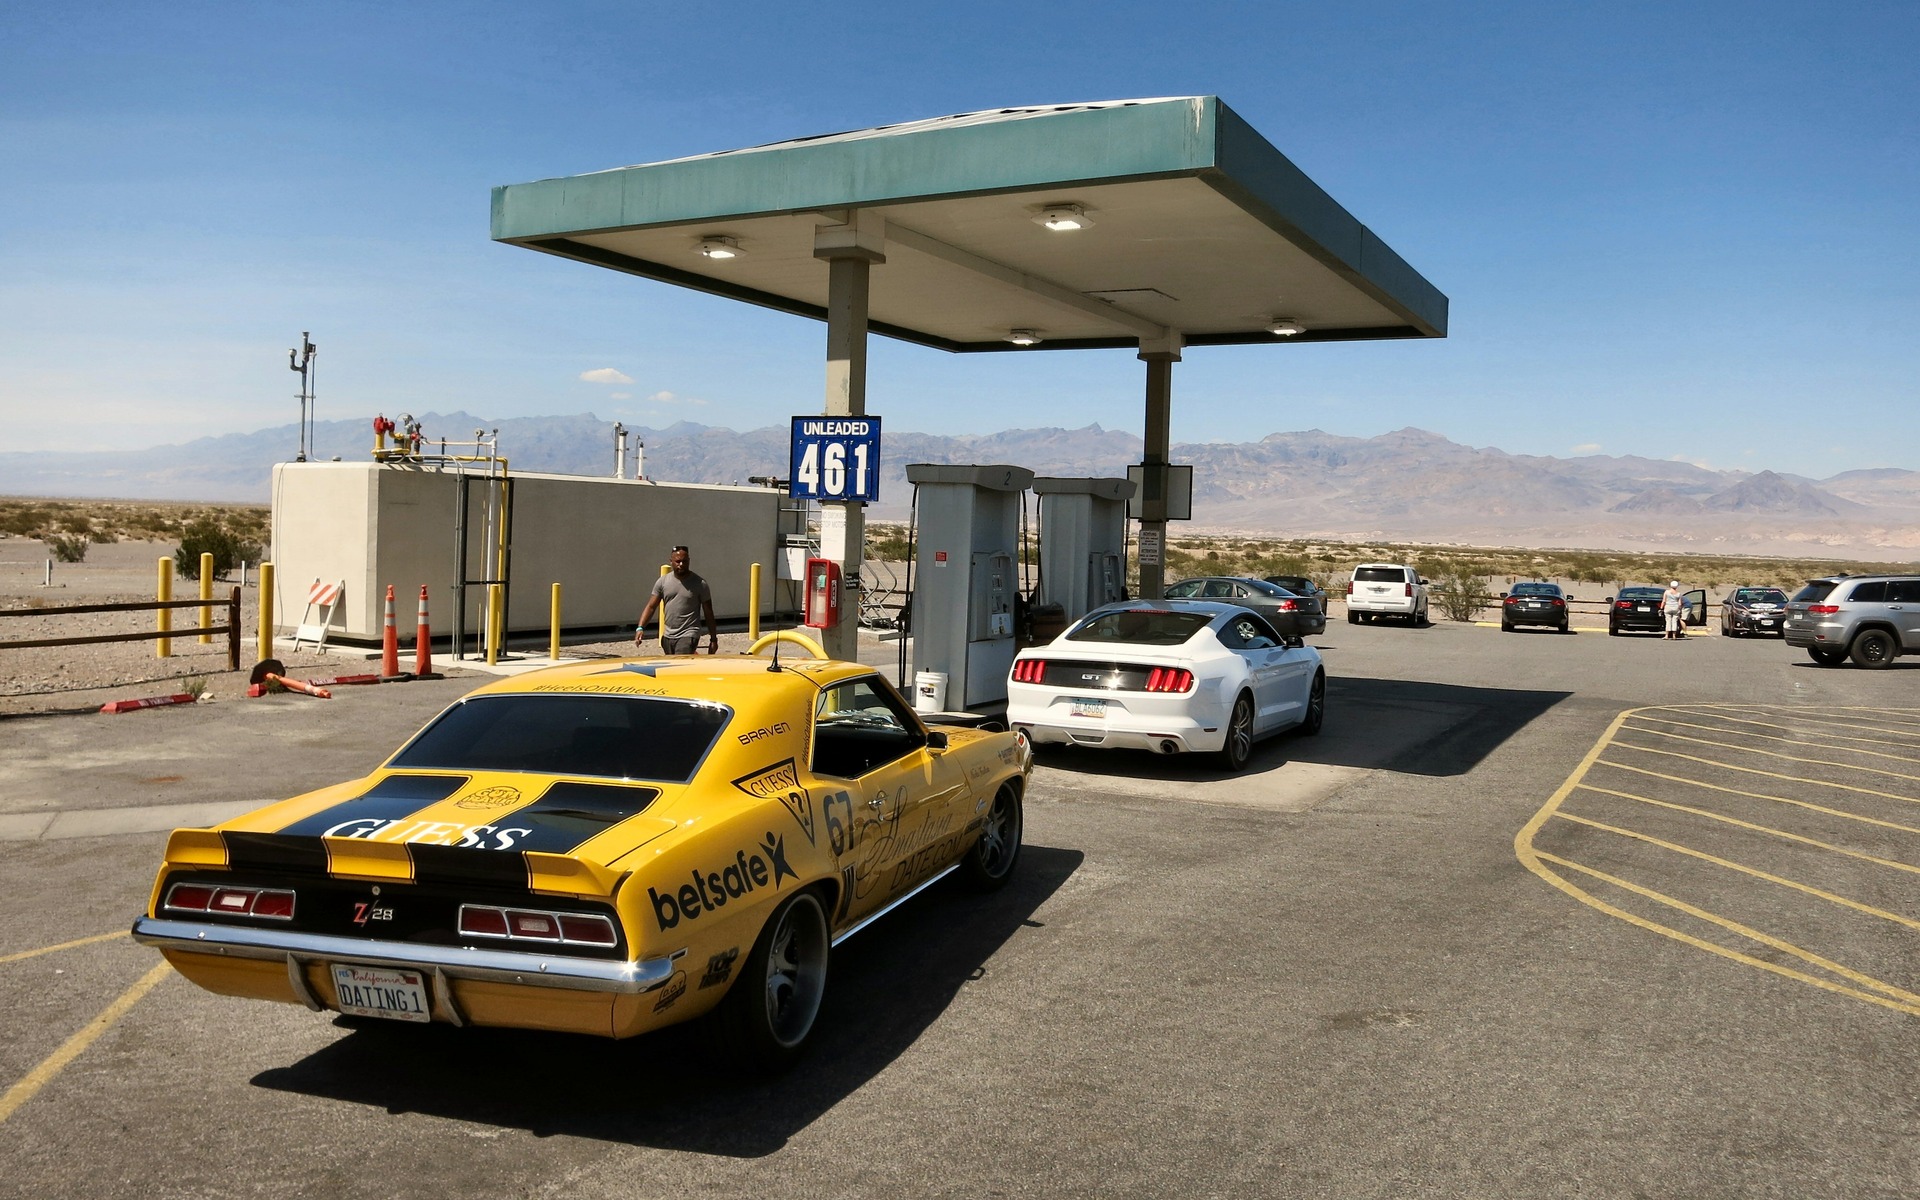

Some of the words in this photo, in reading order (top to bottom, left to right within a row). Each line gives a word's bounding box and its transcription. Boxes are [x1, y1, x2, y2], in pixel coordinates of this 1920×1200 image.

[803, 421, 869, 436] UNLEADED
[798, 442, 867, 496] 461
[1004, 471, 1011, 486] 2
[531, 684, 669, 696] #HeelsOnWheels
[737, 722, 791, 746] BRAVEN
[750, 766, 795, 797] GUESS
[323, 818, 533, 851] GUESS
[823, 790, 854, 857] 67
[647, 849, 769, 933] betsafe
[352, 969, 402, 986] California
